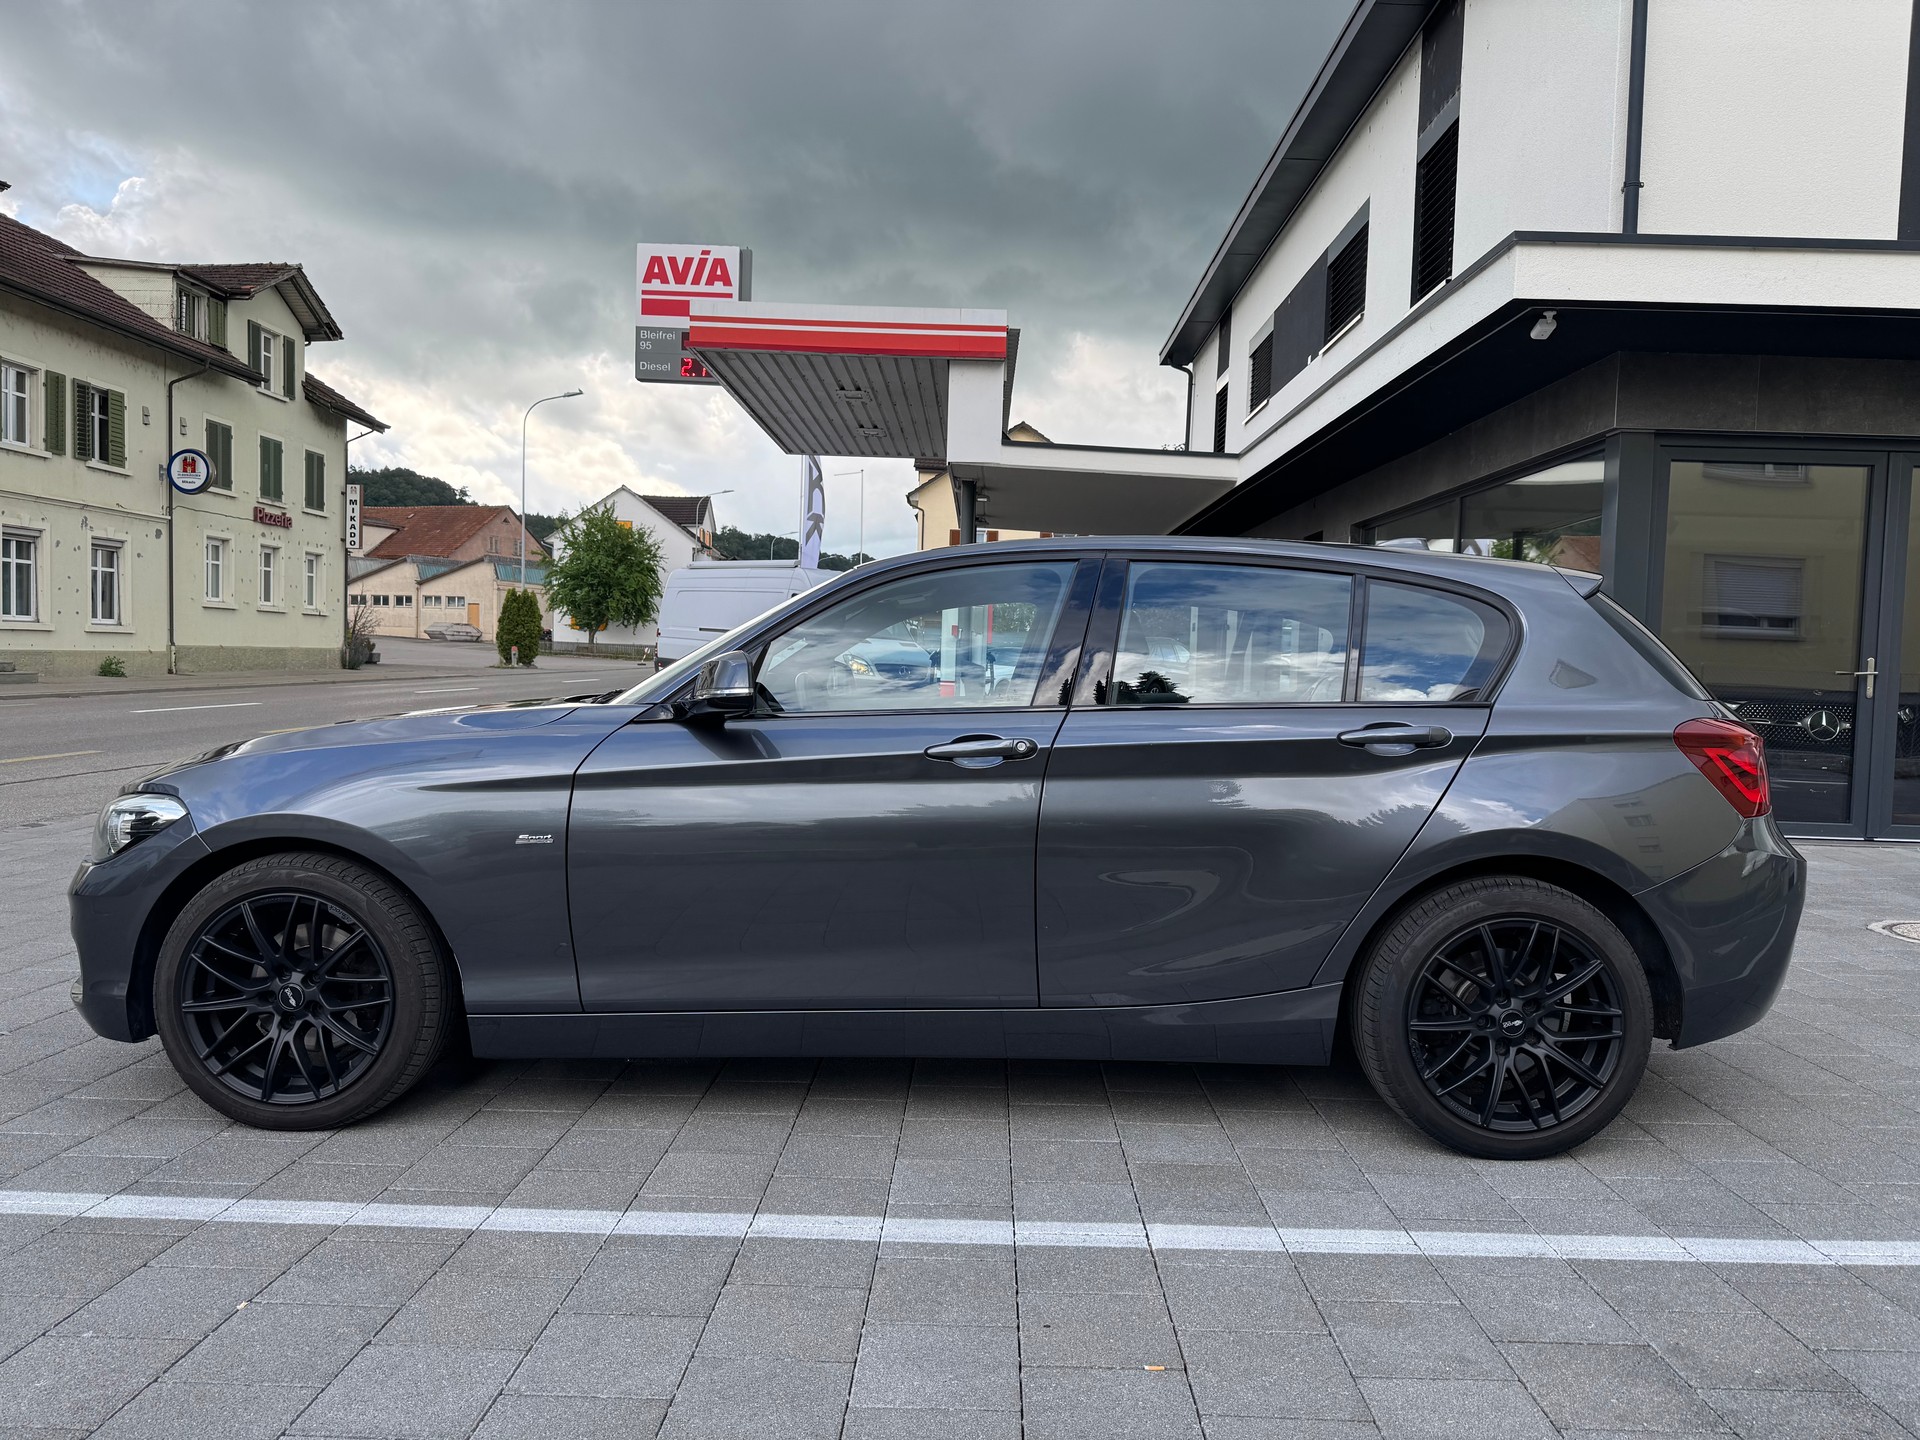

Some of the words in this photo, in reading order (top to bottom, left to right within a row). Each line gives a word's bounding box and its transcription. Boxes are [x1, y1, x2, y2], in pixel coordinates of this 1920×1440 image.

[642, 250, 733, 287] AVIA
[640, 330, 676, 340] Bleifrei
[640, 341, 652, 350] 95
[640, 361, 671, 371] Diesel
[254, 507, 293, 529] Pizzeria
[349, 499, 358, 547] MIKADO
